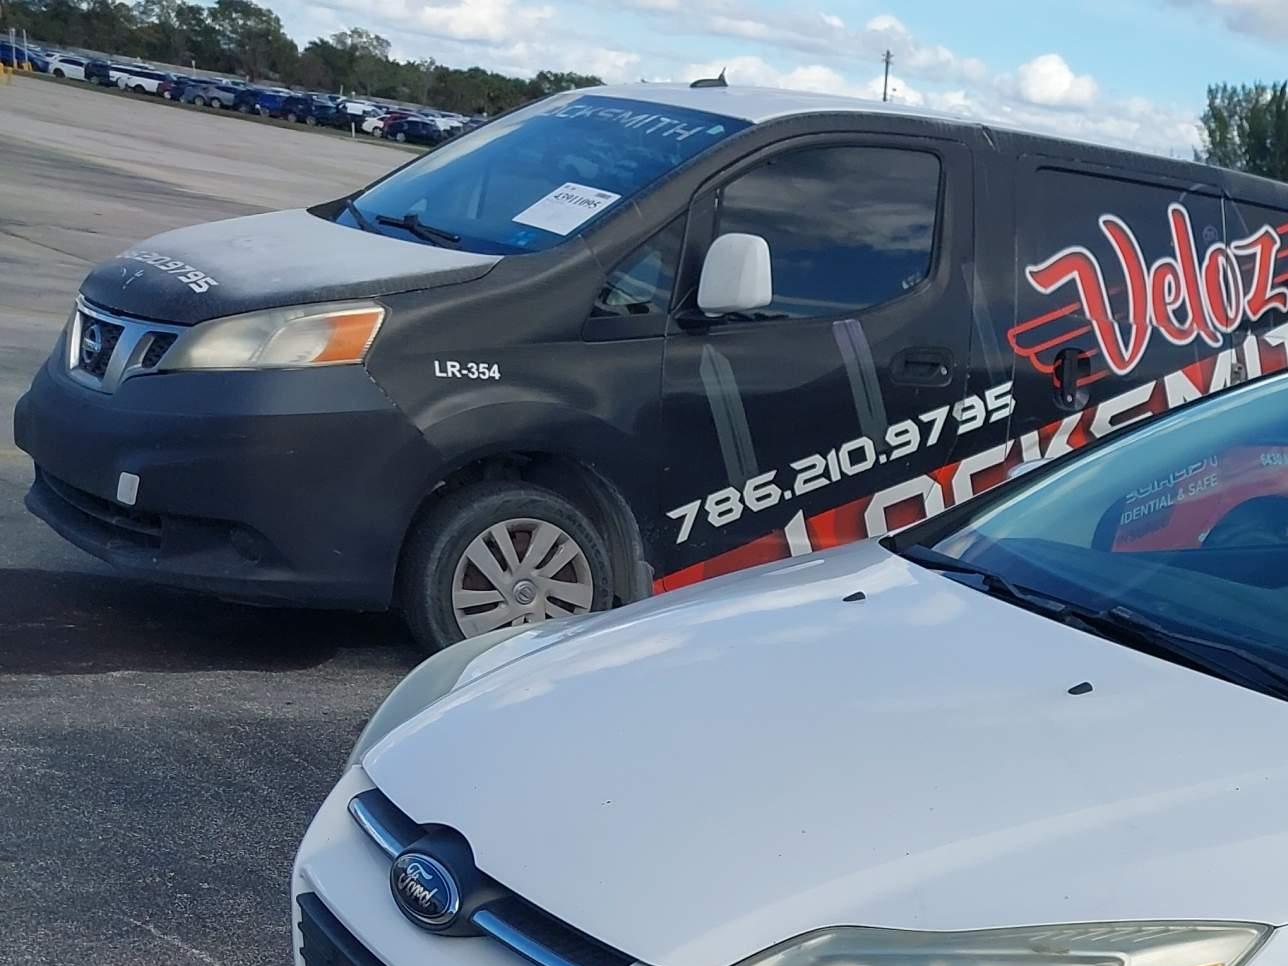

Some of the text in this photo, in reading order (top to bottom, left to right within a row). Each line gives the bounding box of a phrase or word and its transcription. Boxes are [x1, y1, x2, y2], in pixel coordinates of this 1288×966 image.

[434, 360, 501, 380] LR-354
[665, 381, 1016, 545] 786.210.9795
[1187, 473, 1218, 496] SAFE
[398, 862, 437, 908] Ford
